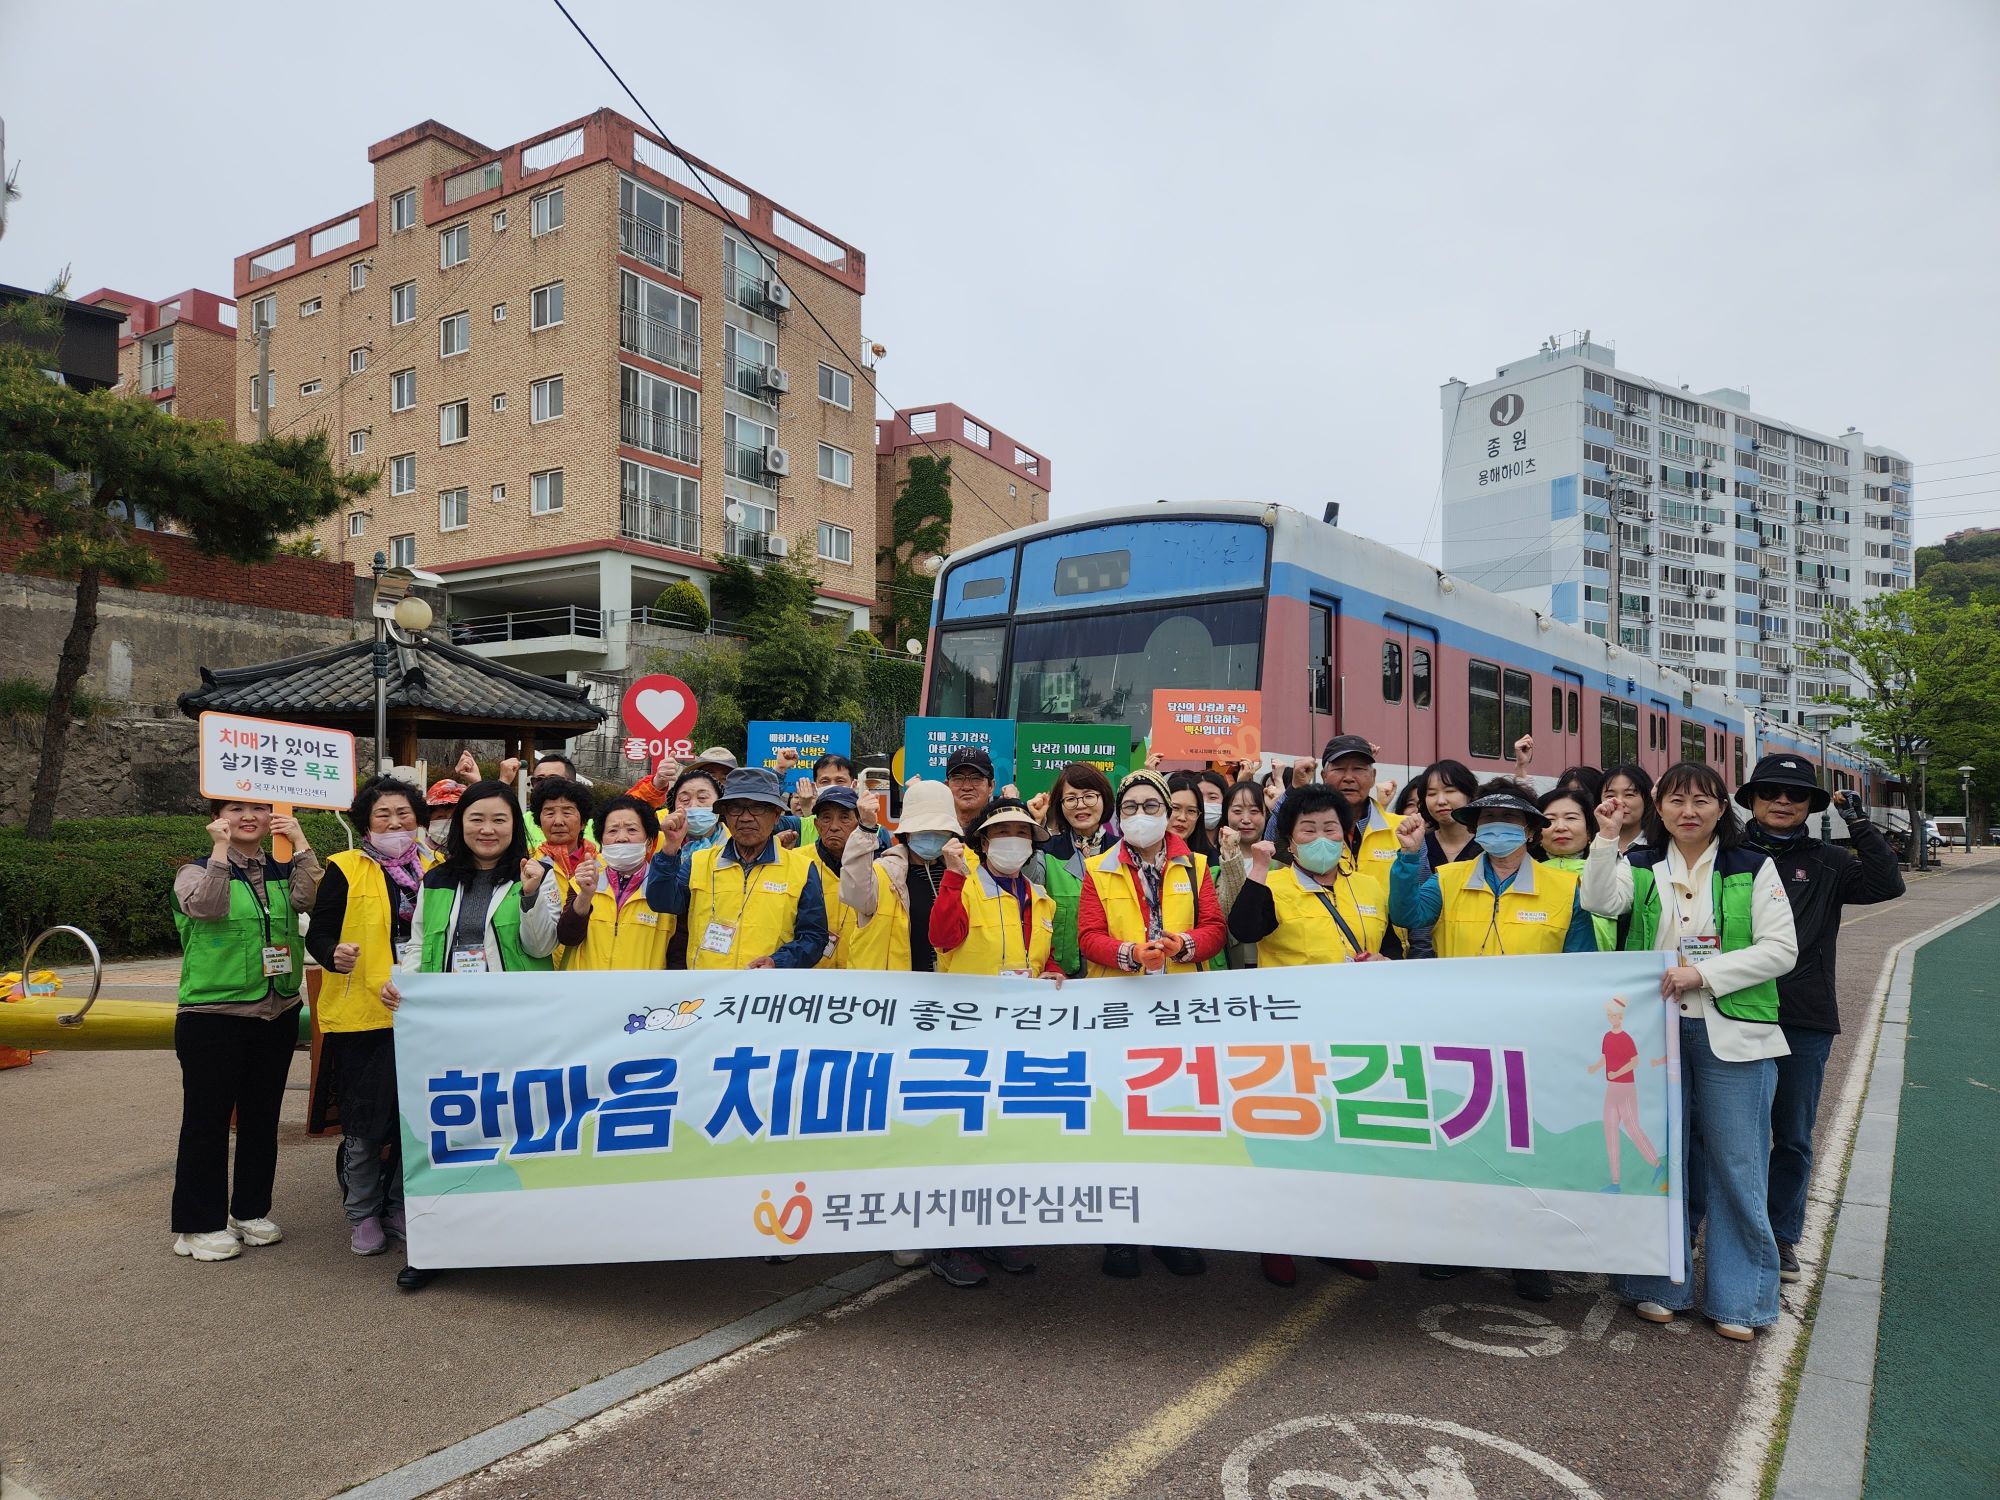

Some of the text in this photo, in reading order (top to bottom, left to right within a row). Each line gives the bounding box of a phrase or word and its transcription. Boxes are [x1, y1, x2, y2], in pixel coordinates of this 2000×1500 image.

[1478, 458, 1537, 486] 용해하이츠
[1167, 702, 1195, 712] 당신의
[1198, 702, 1225, 713] 사랑과
[1175, 713, 1242, 724] 치매를 치유하는
[927, 731, 947, 742] 치매
[1184, 725, 1233, 736] 백신입니다.
[218, 728, 340, 760] 치매가 있어도
[769, 733, 829, 744] 배회가능어르신
[624, 737, 695, 760] 좋아요
[800, 746, 826, 757] 신청은
[928, 743, 966, 755] 아름다
[1031, 743, 1060, 754] 뇌건강
[1064, 743, 1091, 755] 100세
[219, 751, 341, 782] 살기좋은 목포
[1032, 759, 1041, 770] 그
[254, 781, 328, 798] 목포시치매안심센터
[713, 994, 898, 1026] 치매예방에
[909, 1000, 983, 1031] 좋은
[1147, 994, 1302, 1027] 실천하는
[427, 1043, 1534, 1166] 한마음 치매극복 건강걷기
[822, 1184, 1142, 1230] 목포시치매안심센터
